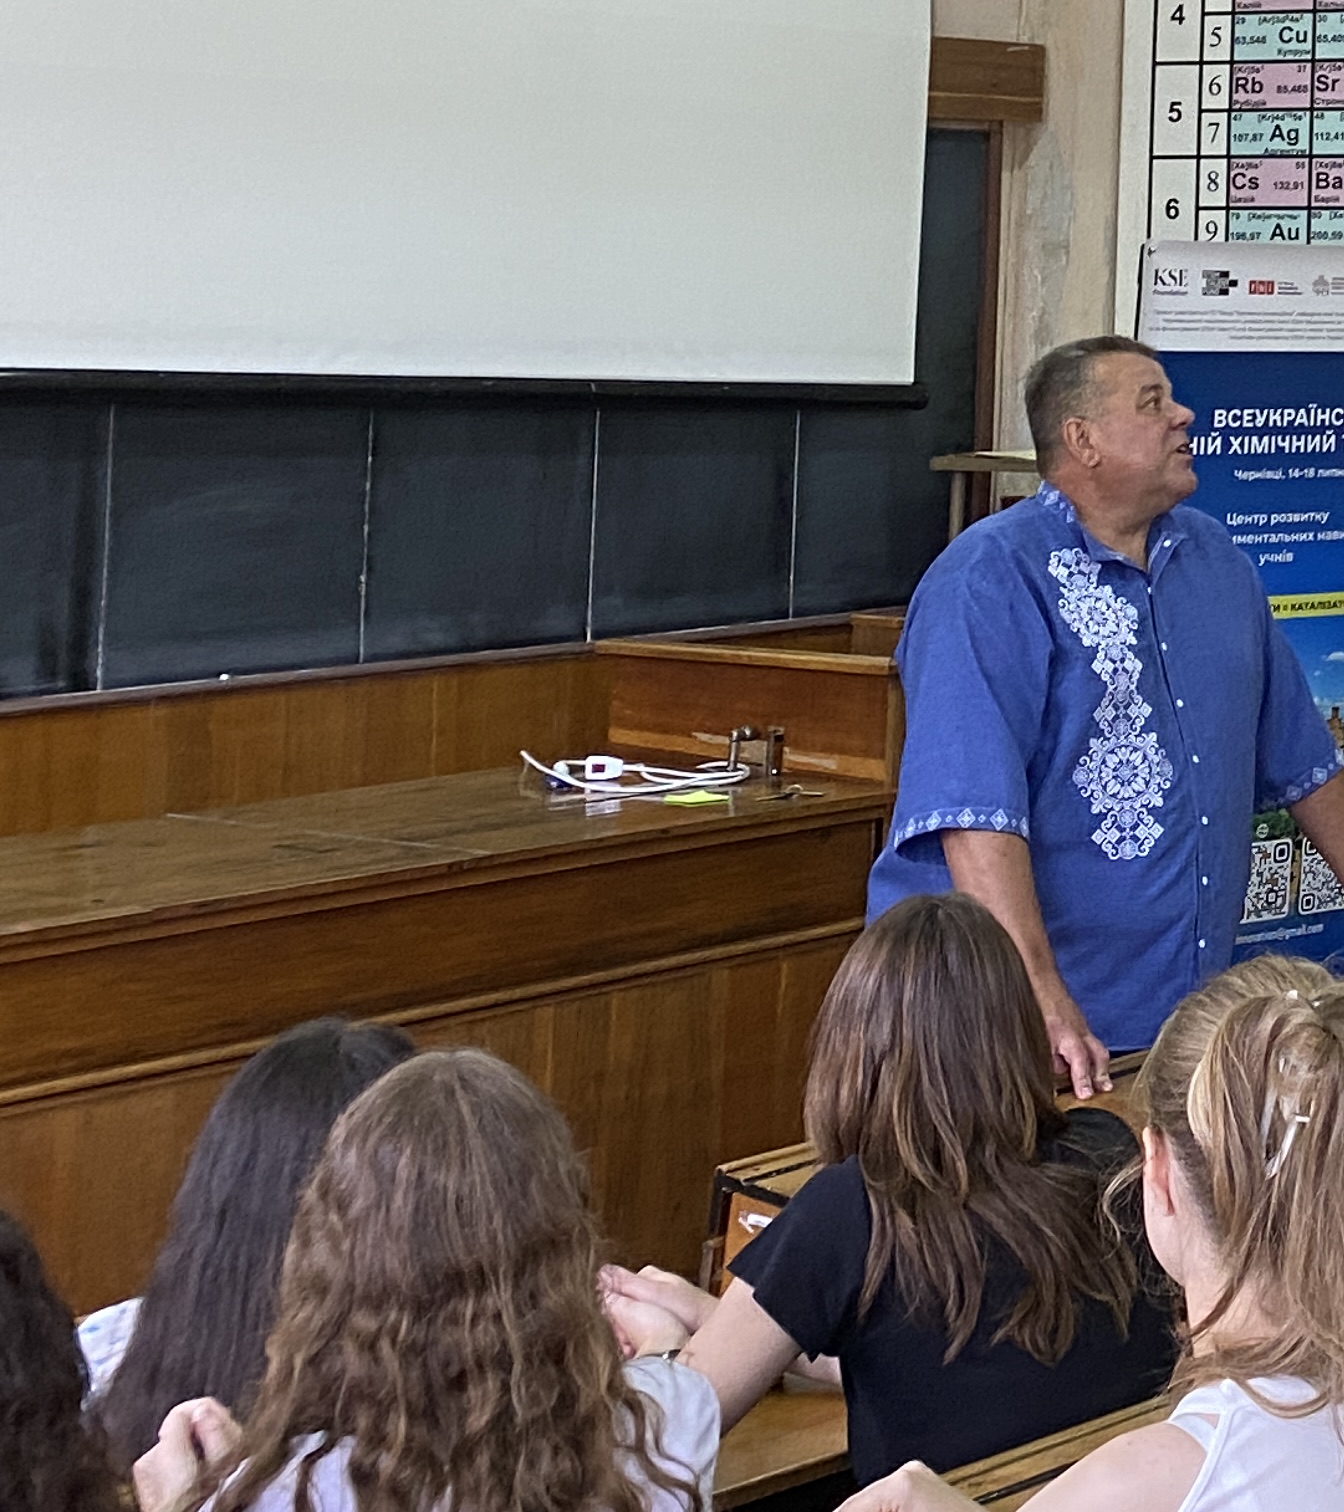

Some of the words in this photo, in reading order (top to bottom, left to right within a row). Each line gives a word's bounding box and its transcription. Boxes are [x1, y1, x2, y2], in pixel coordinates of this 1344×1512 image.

[1170, 4, 1186, 26] 4
[1209, 26, 1222, 48] 5
[1278, 26, 1308, 44] Cu
[1208, 75, 1222, 96] 6
[1234, 76, 1264, 94] Rb
[1315, 74, 1340, 92] Sr
[1168, 101, 1182, 123] 5
[1208, 122, 1220, 143] 7
[1269, 124, 1299, 146] Ag
[1207, 171, 1219, 192] 8
[1232, 172, 1259, 190] Cs
[1315, 171, 1343, 190] Ba
[1165, 198, 1179, 220] 6
[1205, 220, 1218, 242] 9
[1269, 222, 1300, 241] Au
[1153, 268, 1188, 286] KSE
[1228, 430, 1336, 455] ХІМІЧНИЙ
[1226, 512, 1268, 526] Центр
[1271, 511, 1330, 526] розвитку
